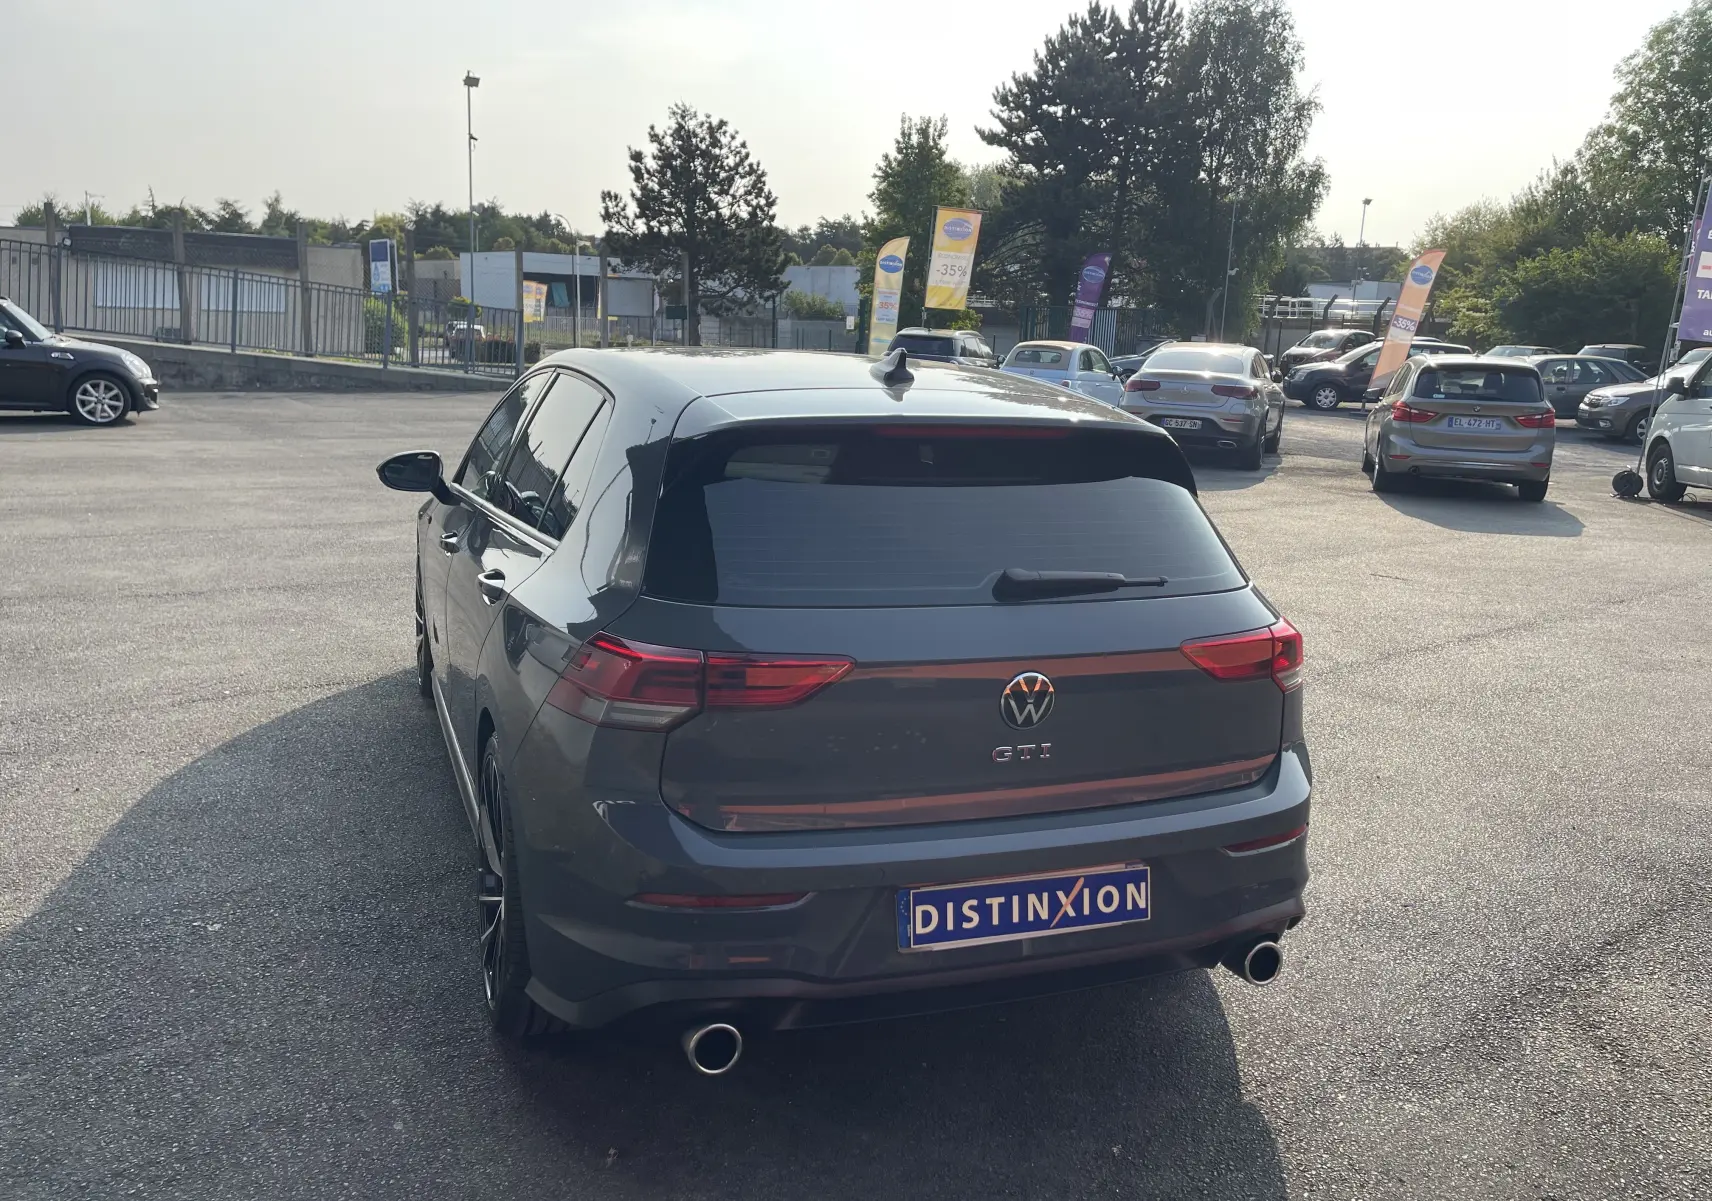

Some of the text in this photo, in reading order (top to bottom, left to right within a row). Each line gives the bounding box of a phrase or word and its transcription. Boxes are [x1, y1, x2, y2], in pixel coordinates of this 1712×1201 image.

[936, 264, 968, 278] -35%
[1393, 317, 1416, 332] -35%
[991, 743, 1052, 762] GTI
[914, 876, 1147, 935] DISTINXION
